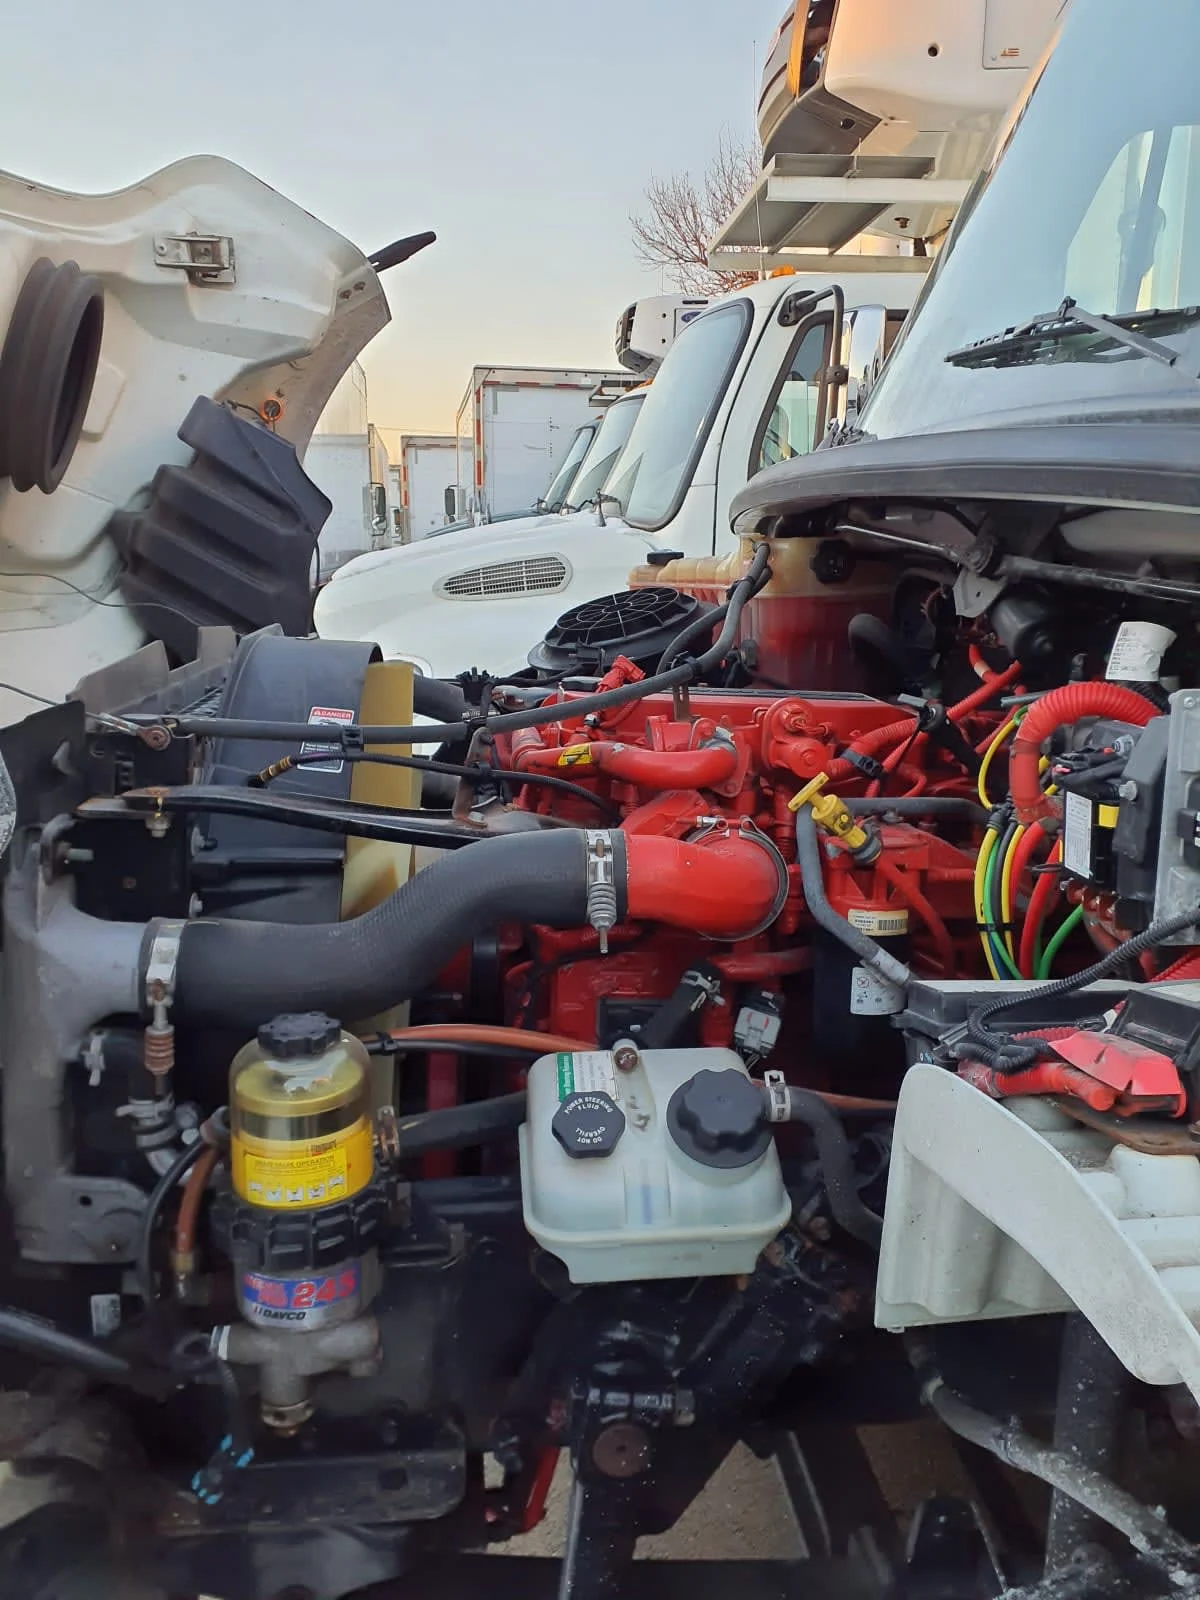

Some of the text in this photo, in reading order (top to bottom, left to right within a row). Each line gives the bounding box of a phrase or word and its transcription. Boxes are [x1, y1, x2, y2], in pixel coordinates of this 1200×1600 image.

[564, 1096, 614, 1114] POWER STEERING
[575, 1126, 606, 1138] OVERFILL
[577, 1136, 602, 1144] DO NOT
[263, 1309, 307, 1321] DAVCO
